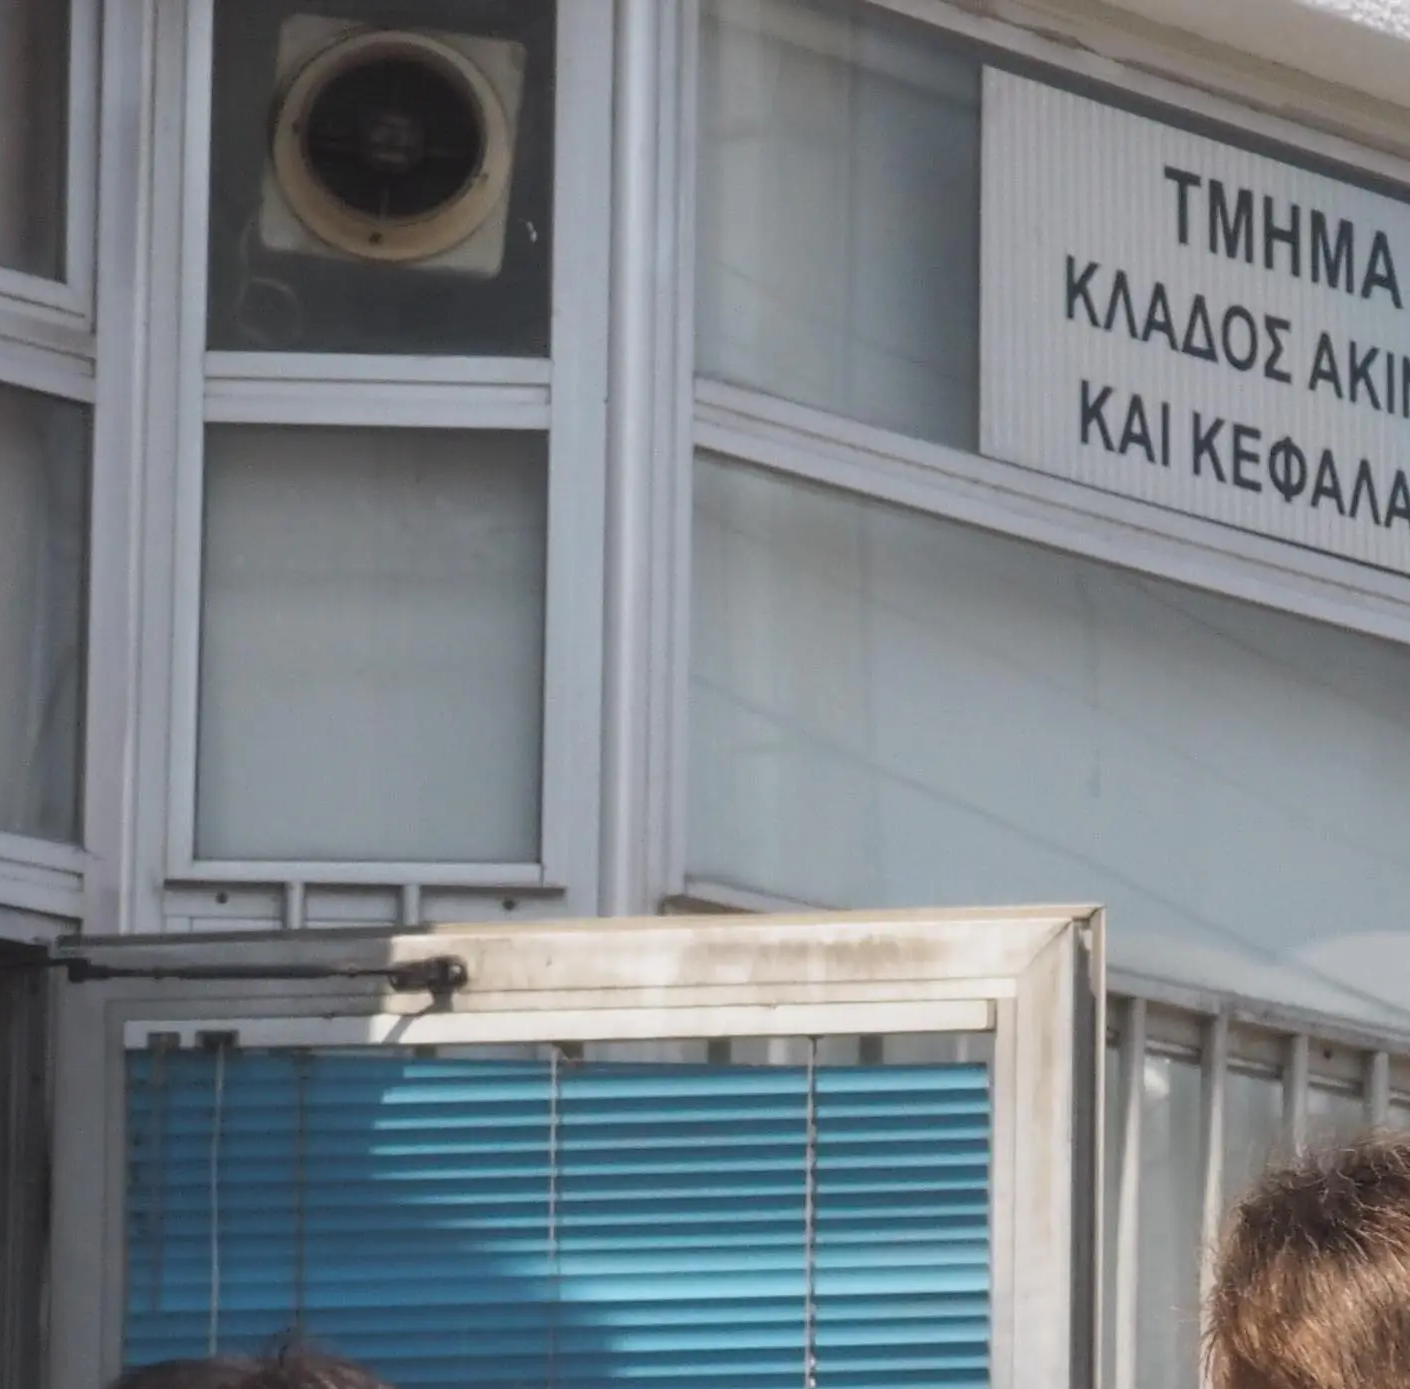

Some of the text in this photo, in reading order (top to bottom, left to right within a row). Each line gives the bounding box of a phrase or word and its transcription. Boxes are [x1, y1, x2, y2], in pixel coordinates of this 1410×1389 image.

[1163, 164, 1404, 310] ΤΜΗΜΑ
[1064, 253, 1293, 386] ΚΛΑΔΟΣ
[1079, 378, 1171, 468] ΚΑΙ
